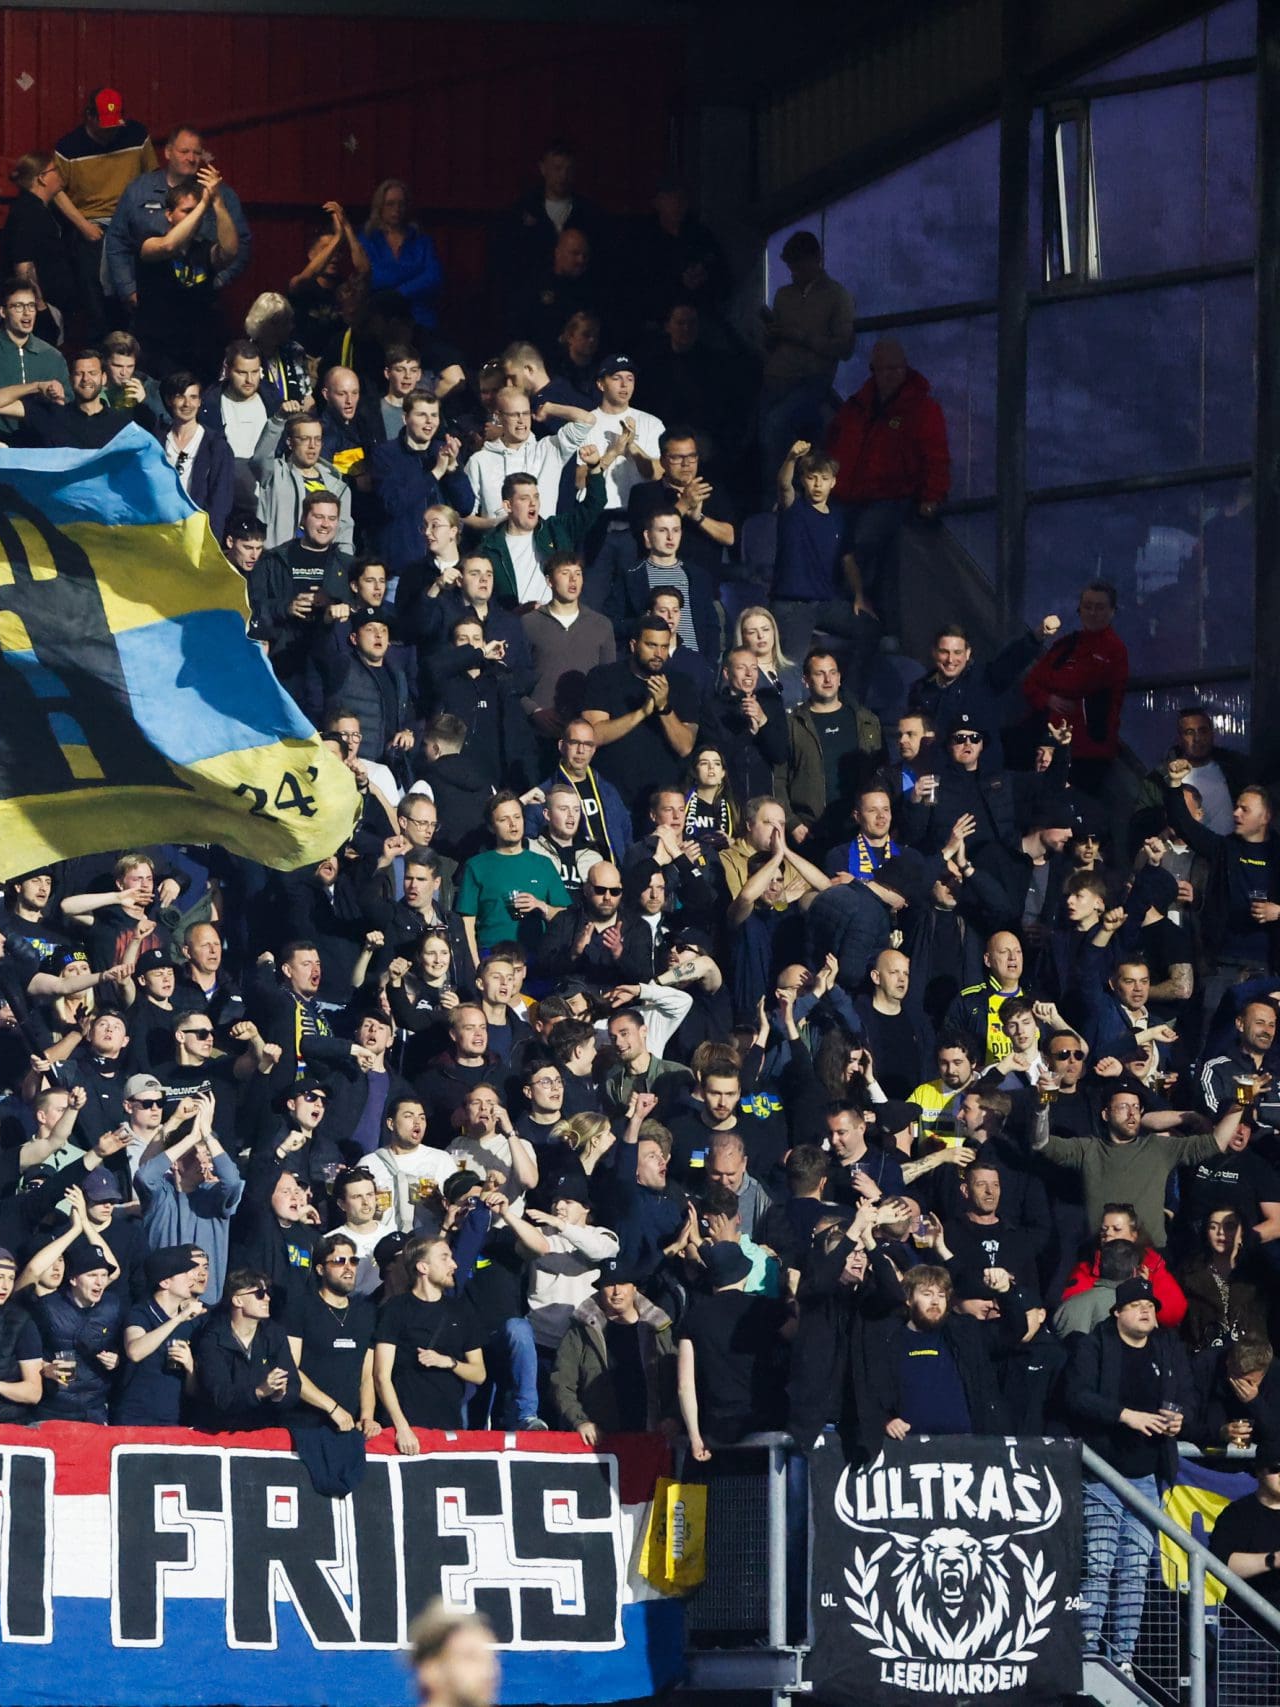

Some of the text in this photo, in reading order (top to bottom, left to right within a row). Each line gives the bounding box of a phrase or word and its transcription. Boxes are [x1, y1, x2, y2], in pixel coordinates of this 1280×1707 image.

[856, 1463, 1042, 1522] ULTRAS
[111, 1444, 625, 1650] FRIES
[672, 1500, 686, 1560] JUMBO
[821, 1593, 837, 1607] UL
[880, 1662, 1028, 1695] LEEUWARDEN
